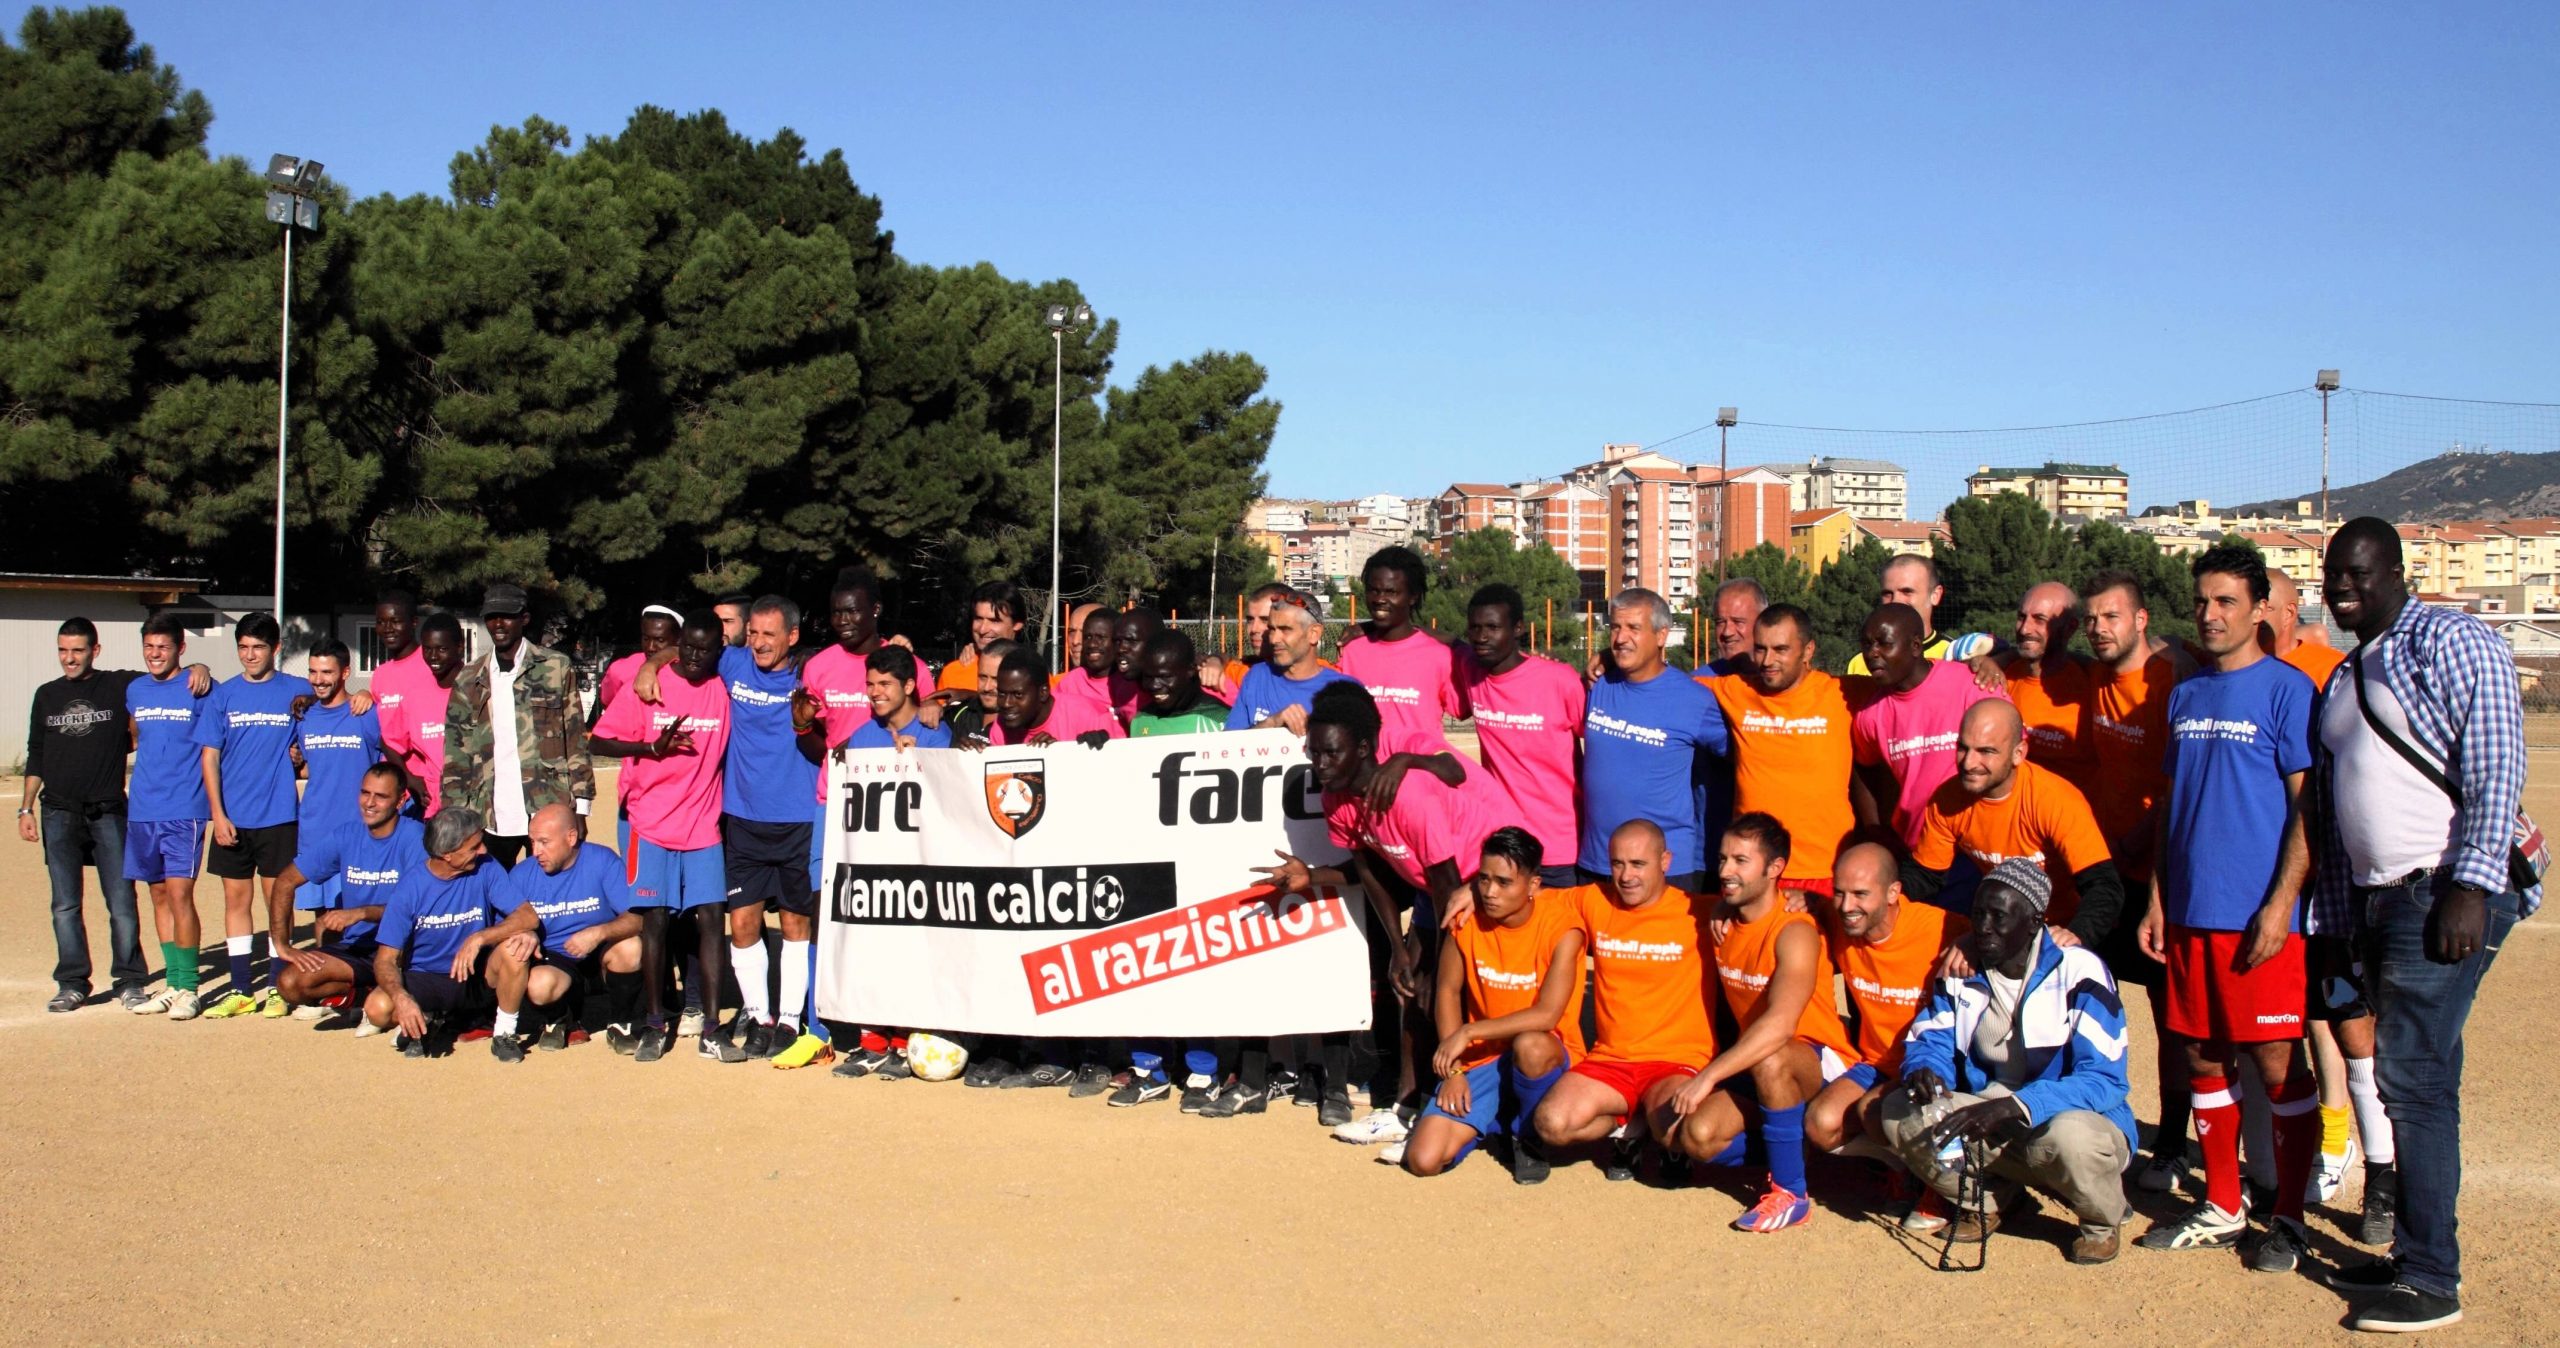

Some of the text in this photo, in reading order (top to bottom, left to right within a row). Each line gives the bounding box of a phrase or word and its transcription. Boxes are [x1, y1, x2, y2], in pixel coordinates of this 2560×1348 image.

[732, 684, 768, 702] football
[1385, 687, 1420, 700] people
[262, 712, 290, 722] people
[1473, 706, 1544, 725] football people
[1743, 714, 1828, 729] football people
[1588, 712, 1668, 741] football people
[2212, 720, 2258, 736] people
[332, 735, 362, 744] people
[1924, 731, 1959, 748] people
[2220, 732, 2254, 744] Weeks
[1152, 751, 1325, 826] fare
[347, 869, 380, 880] football
[567, 896, 600, 911] people
[936, 880, 976, 922] un
[454, 907, 483, 923] people
[1040, 886, 1335, 1005] al razzismo!
[1596, 936, 1684, 955] football people
[2256, 1014, 2300, 1024] macron
